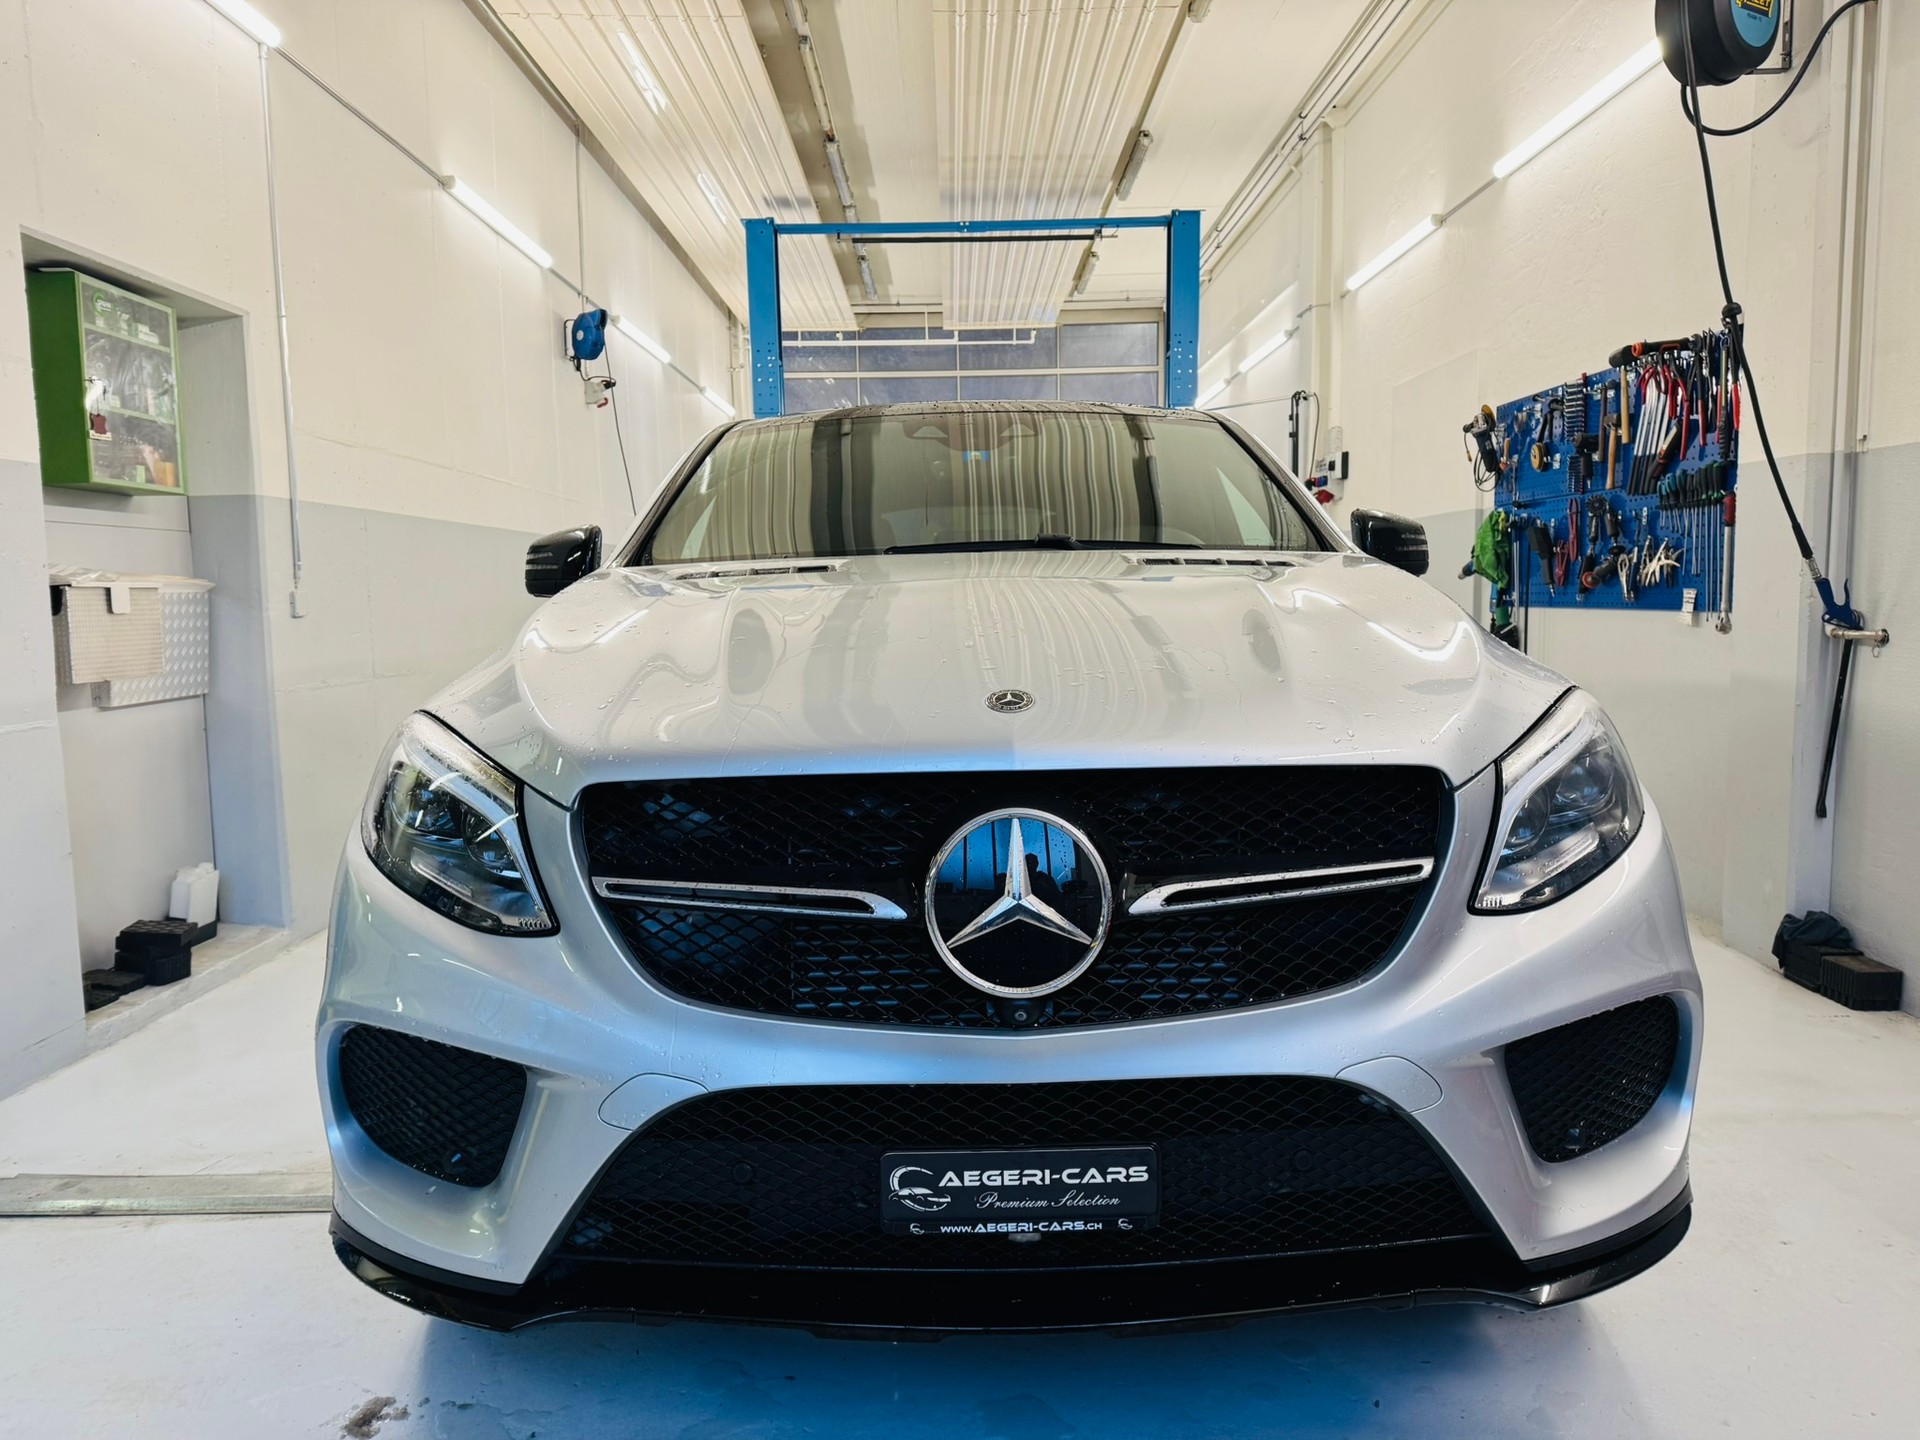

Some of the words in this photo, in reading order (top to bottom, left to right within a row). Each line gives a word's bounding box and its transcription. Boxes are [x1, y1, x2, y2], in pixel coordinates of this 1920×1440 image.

[938, 1166, 1149, 1187] AEGERI-CARS
[976, 1191, 1049, 1209] Premium
[1051, 1189, 1121, 1208] Selection
